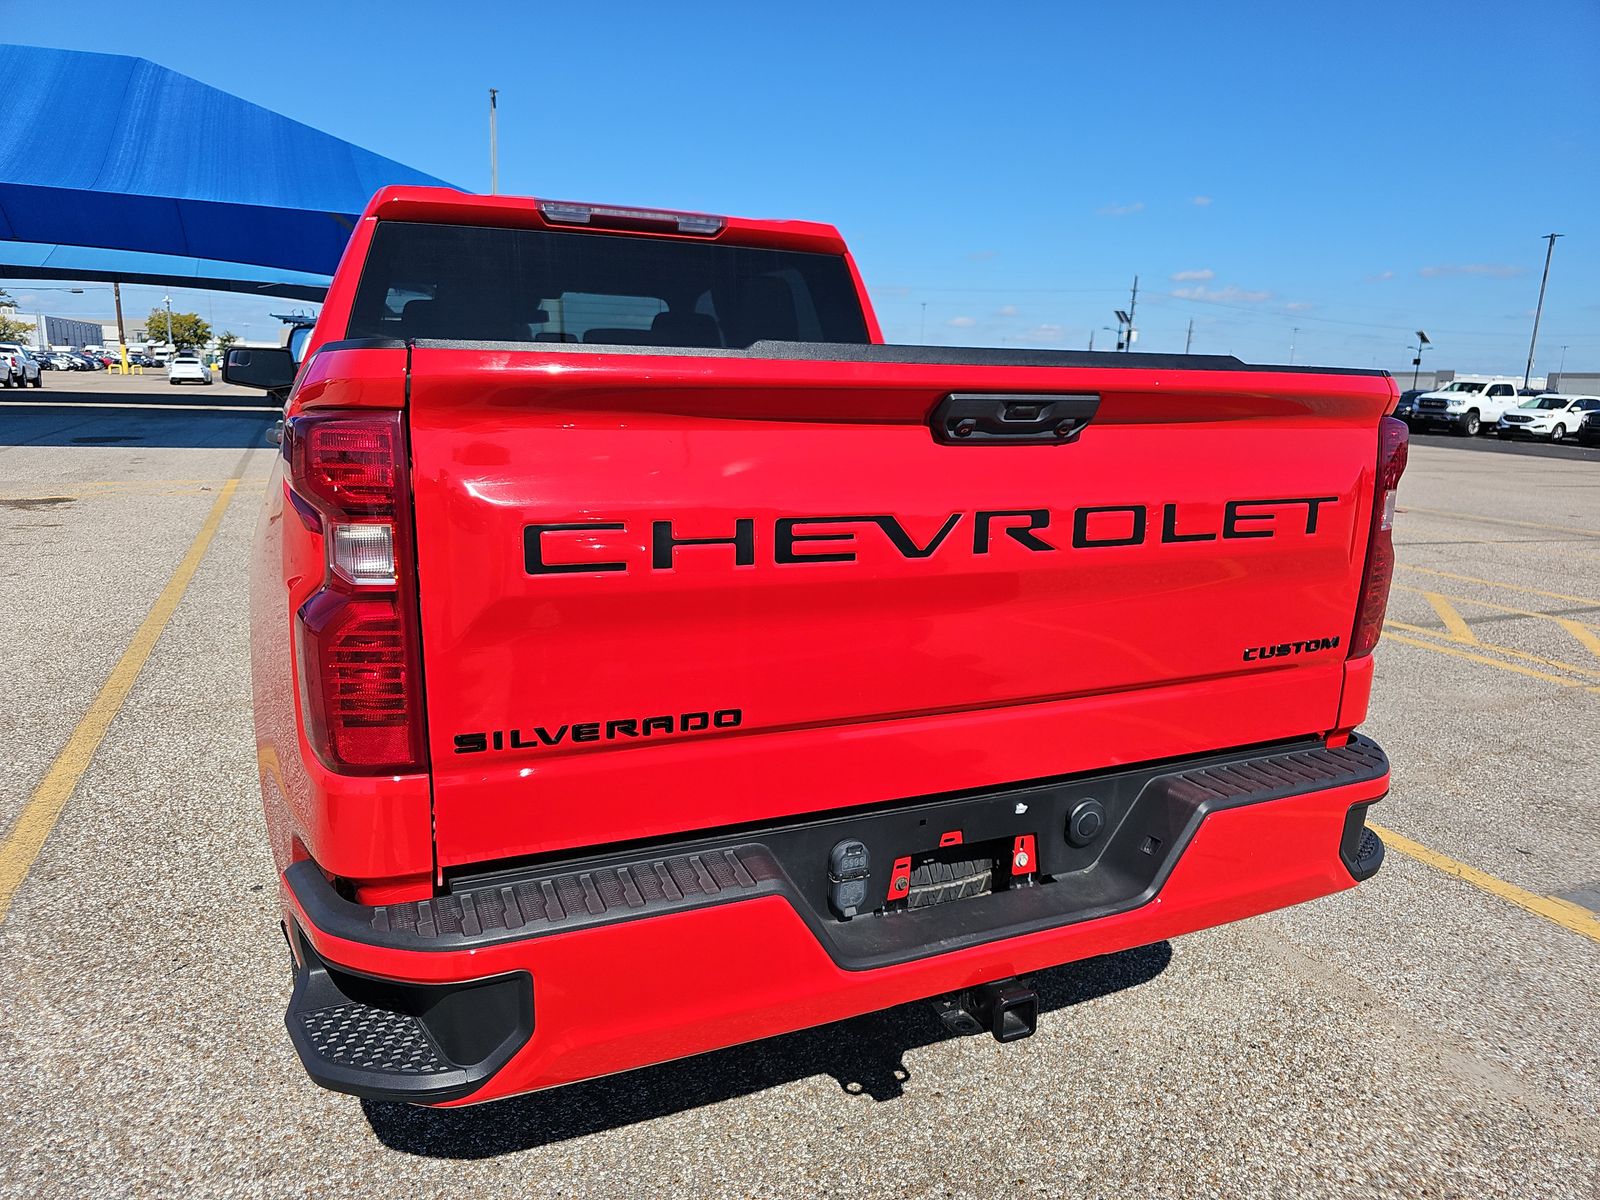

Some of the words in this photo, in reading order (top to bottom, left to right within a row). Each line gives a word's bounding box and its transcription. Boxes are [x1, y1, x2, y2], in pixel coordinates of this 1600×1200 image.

[524, 497, 1338, 574] CHEVROLET
[1243, 636, 1340, 661] CUSTOM
[454, 709, 742, 754] SILVERADO
